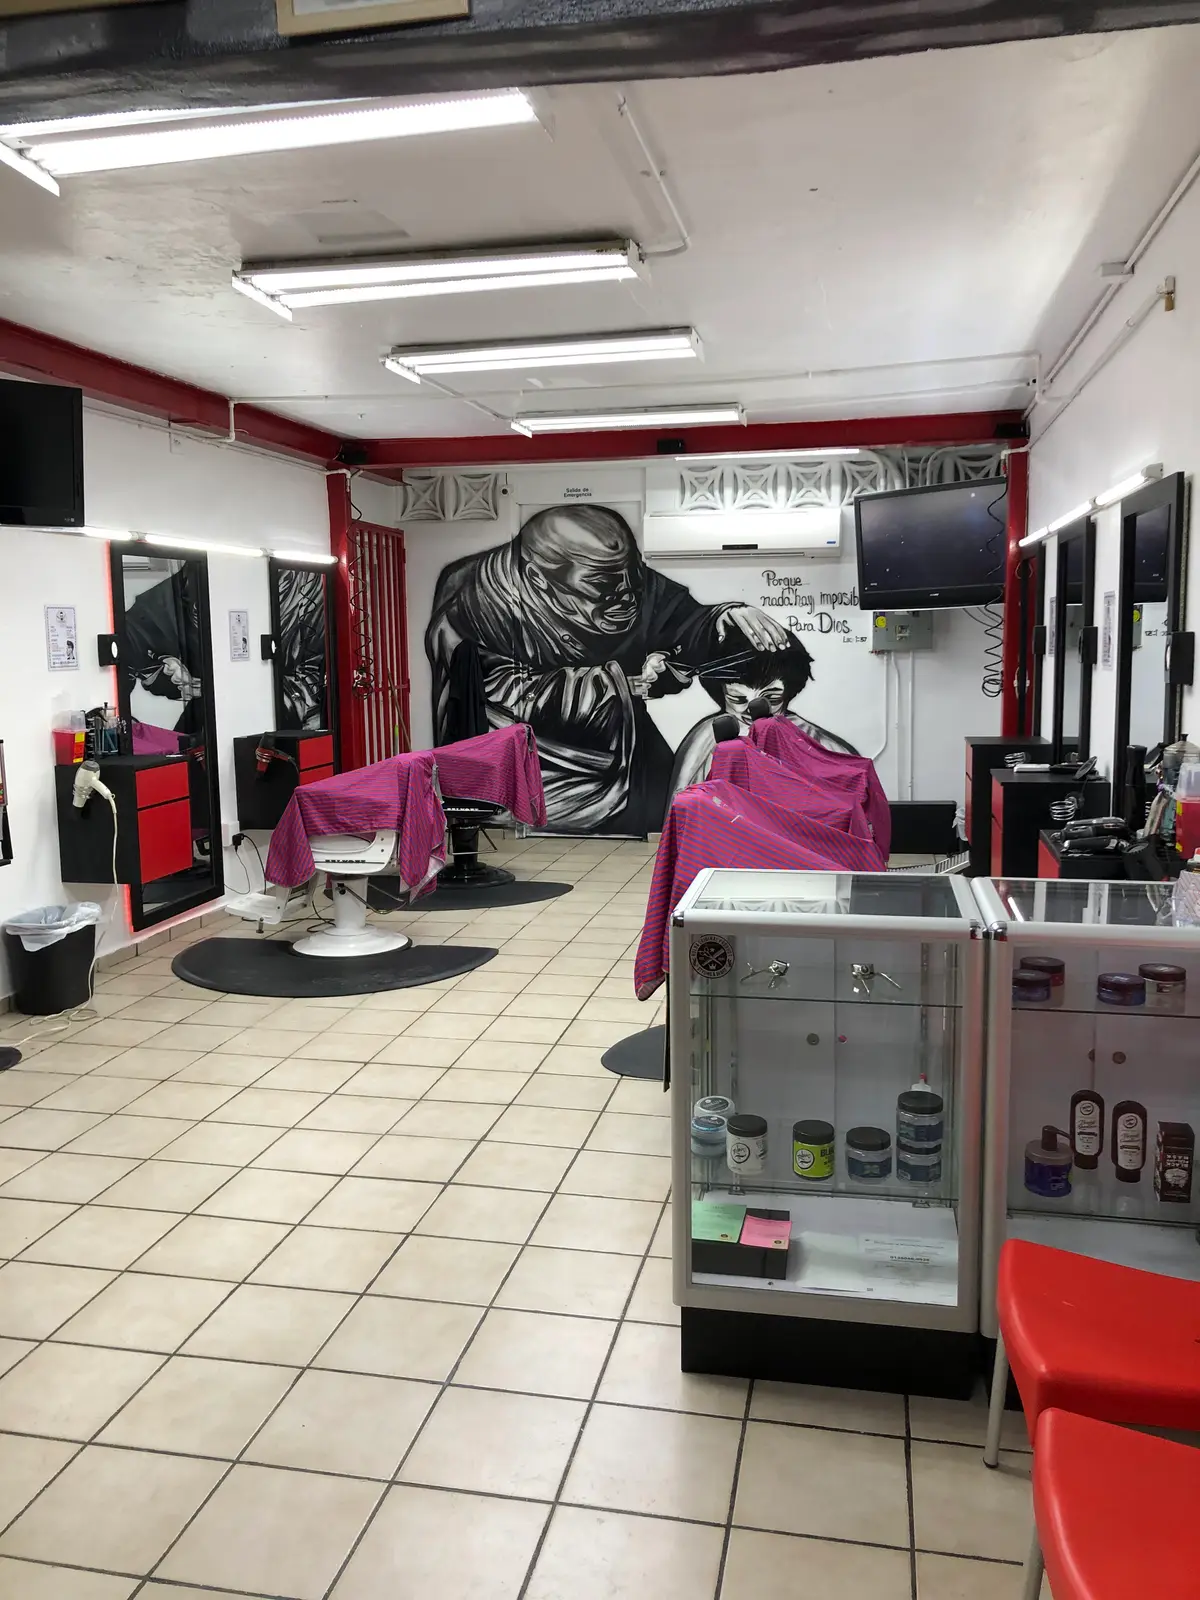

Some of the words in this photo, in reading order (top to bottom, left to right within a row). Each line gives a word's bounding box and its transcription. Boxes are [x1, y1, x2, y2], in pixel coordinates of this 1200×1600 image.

[762, 570, 803, 593] Porque
[760, 587, 793, 606] nada
[794, 588, 815, 615] hay
[819, 587, 860, 610] imposib
[786, 615, 815, 632] Para
